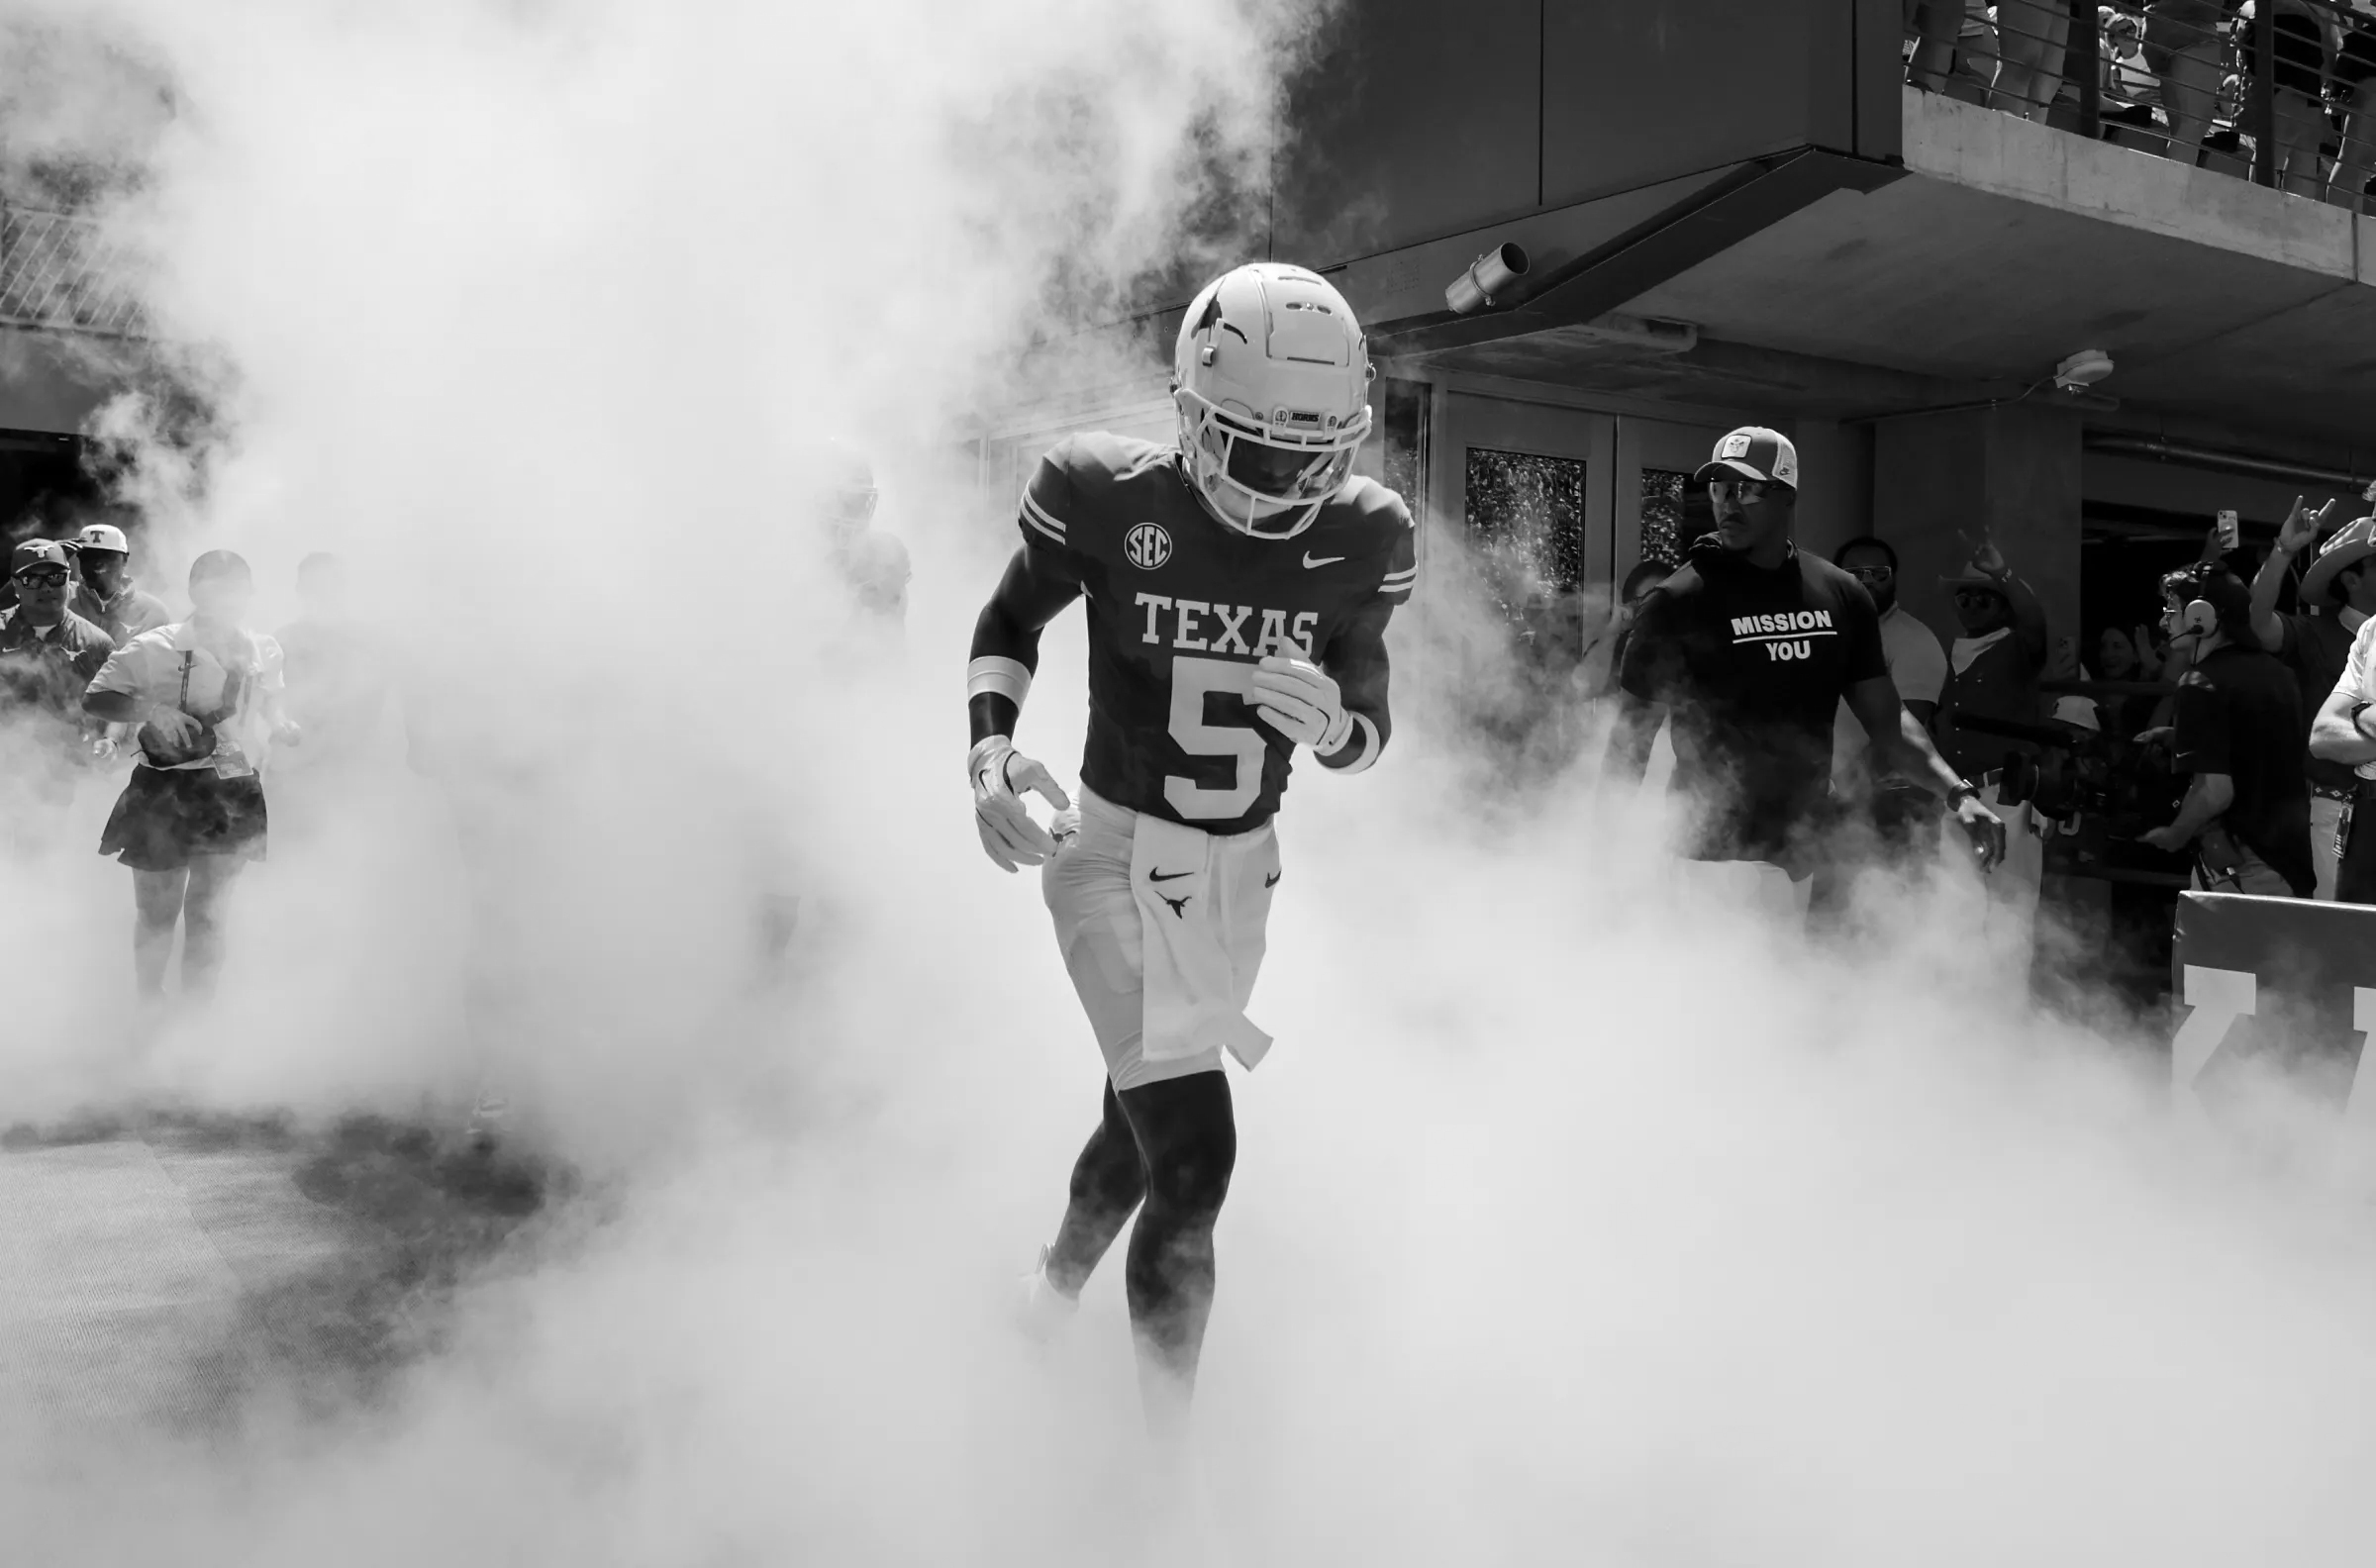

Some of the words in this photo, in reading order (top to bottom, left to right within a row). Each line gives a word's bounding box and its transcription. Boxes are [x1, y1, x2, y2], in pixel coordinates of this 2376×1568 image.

[90, 531, 105, 543] T
[1129, 526, 1168, 567] SEC
[1135, 592, 1319, 658] TEXAS
[1731, 610, 1832, 636] MISSION
[1765, 639, 1811, 661] YOU
[1163, 655, 1267, 820] 5
